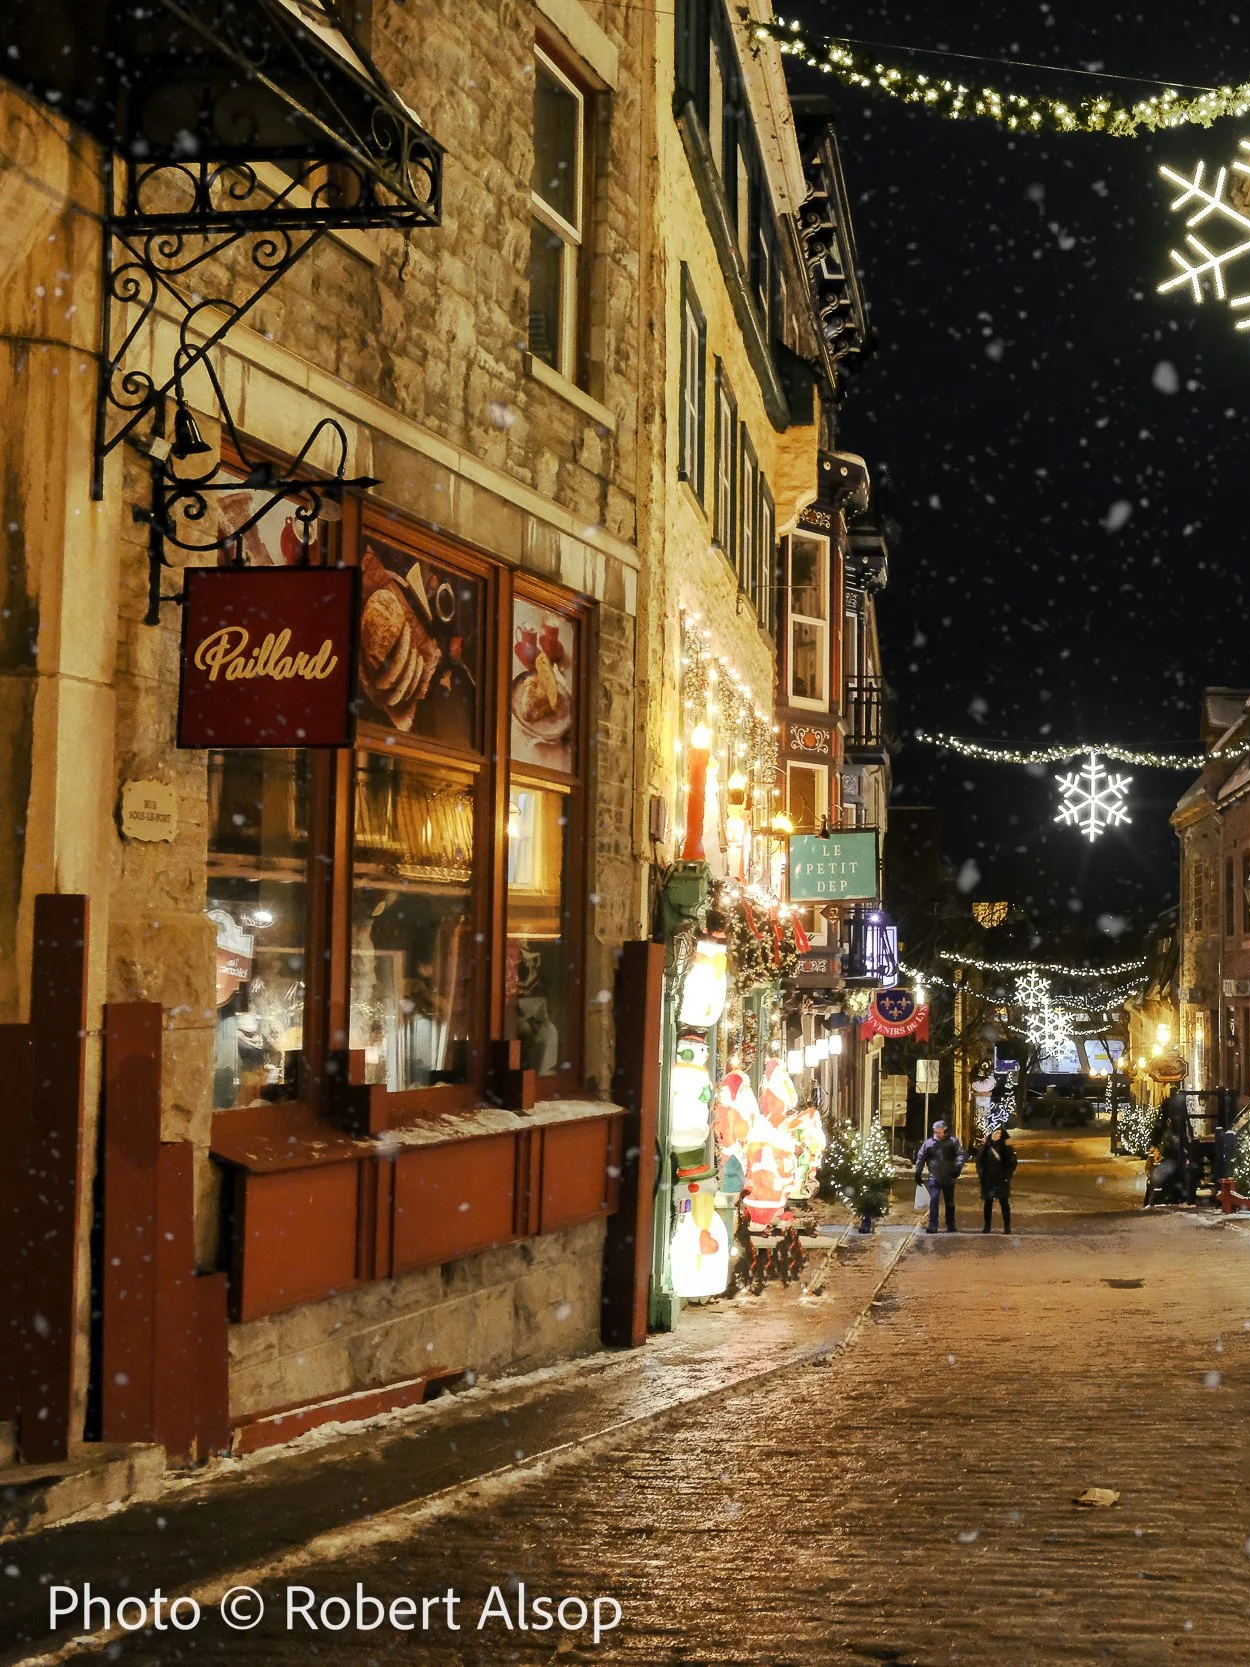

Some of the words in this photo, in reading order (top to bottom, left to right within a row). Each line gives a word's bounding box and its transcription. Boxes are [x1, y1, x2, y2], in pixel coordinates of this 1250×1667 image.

[194, 626, 339, 682] Paillard
[822, 844, 842, 856] LE
[806, 862, 858, 875] PETIT
[817, 880, 848, 893] DEP
[906, 1021, 918, 1032] DU
[915, 1004, 928, 1022] LYS
